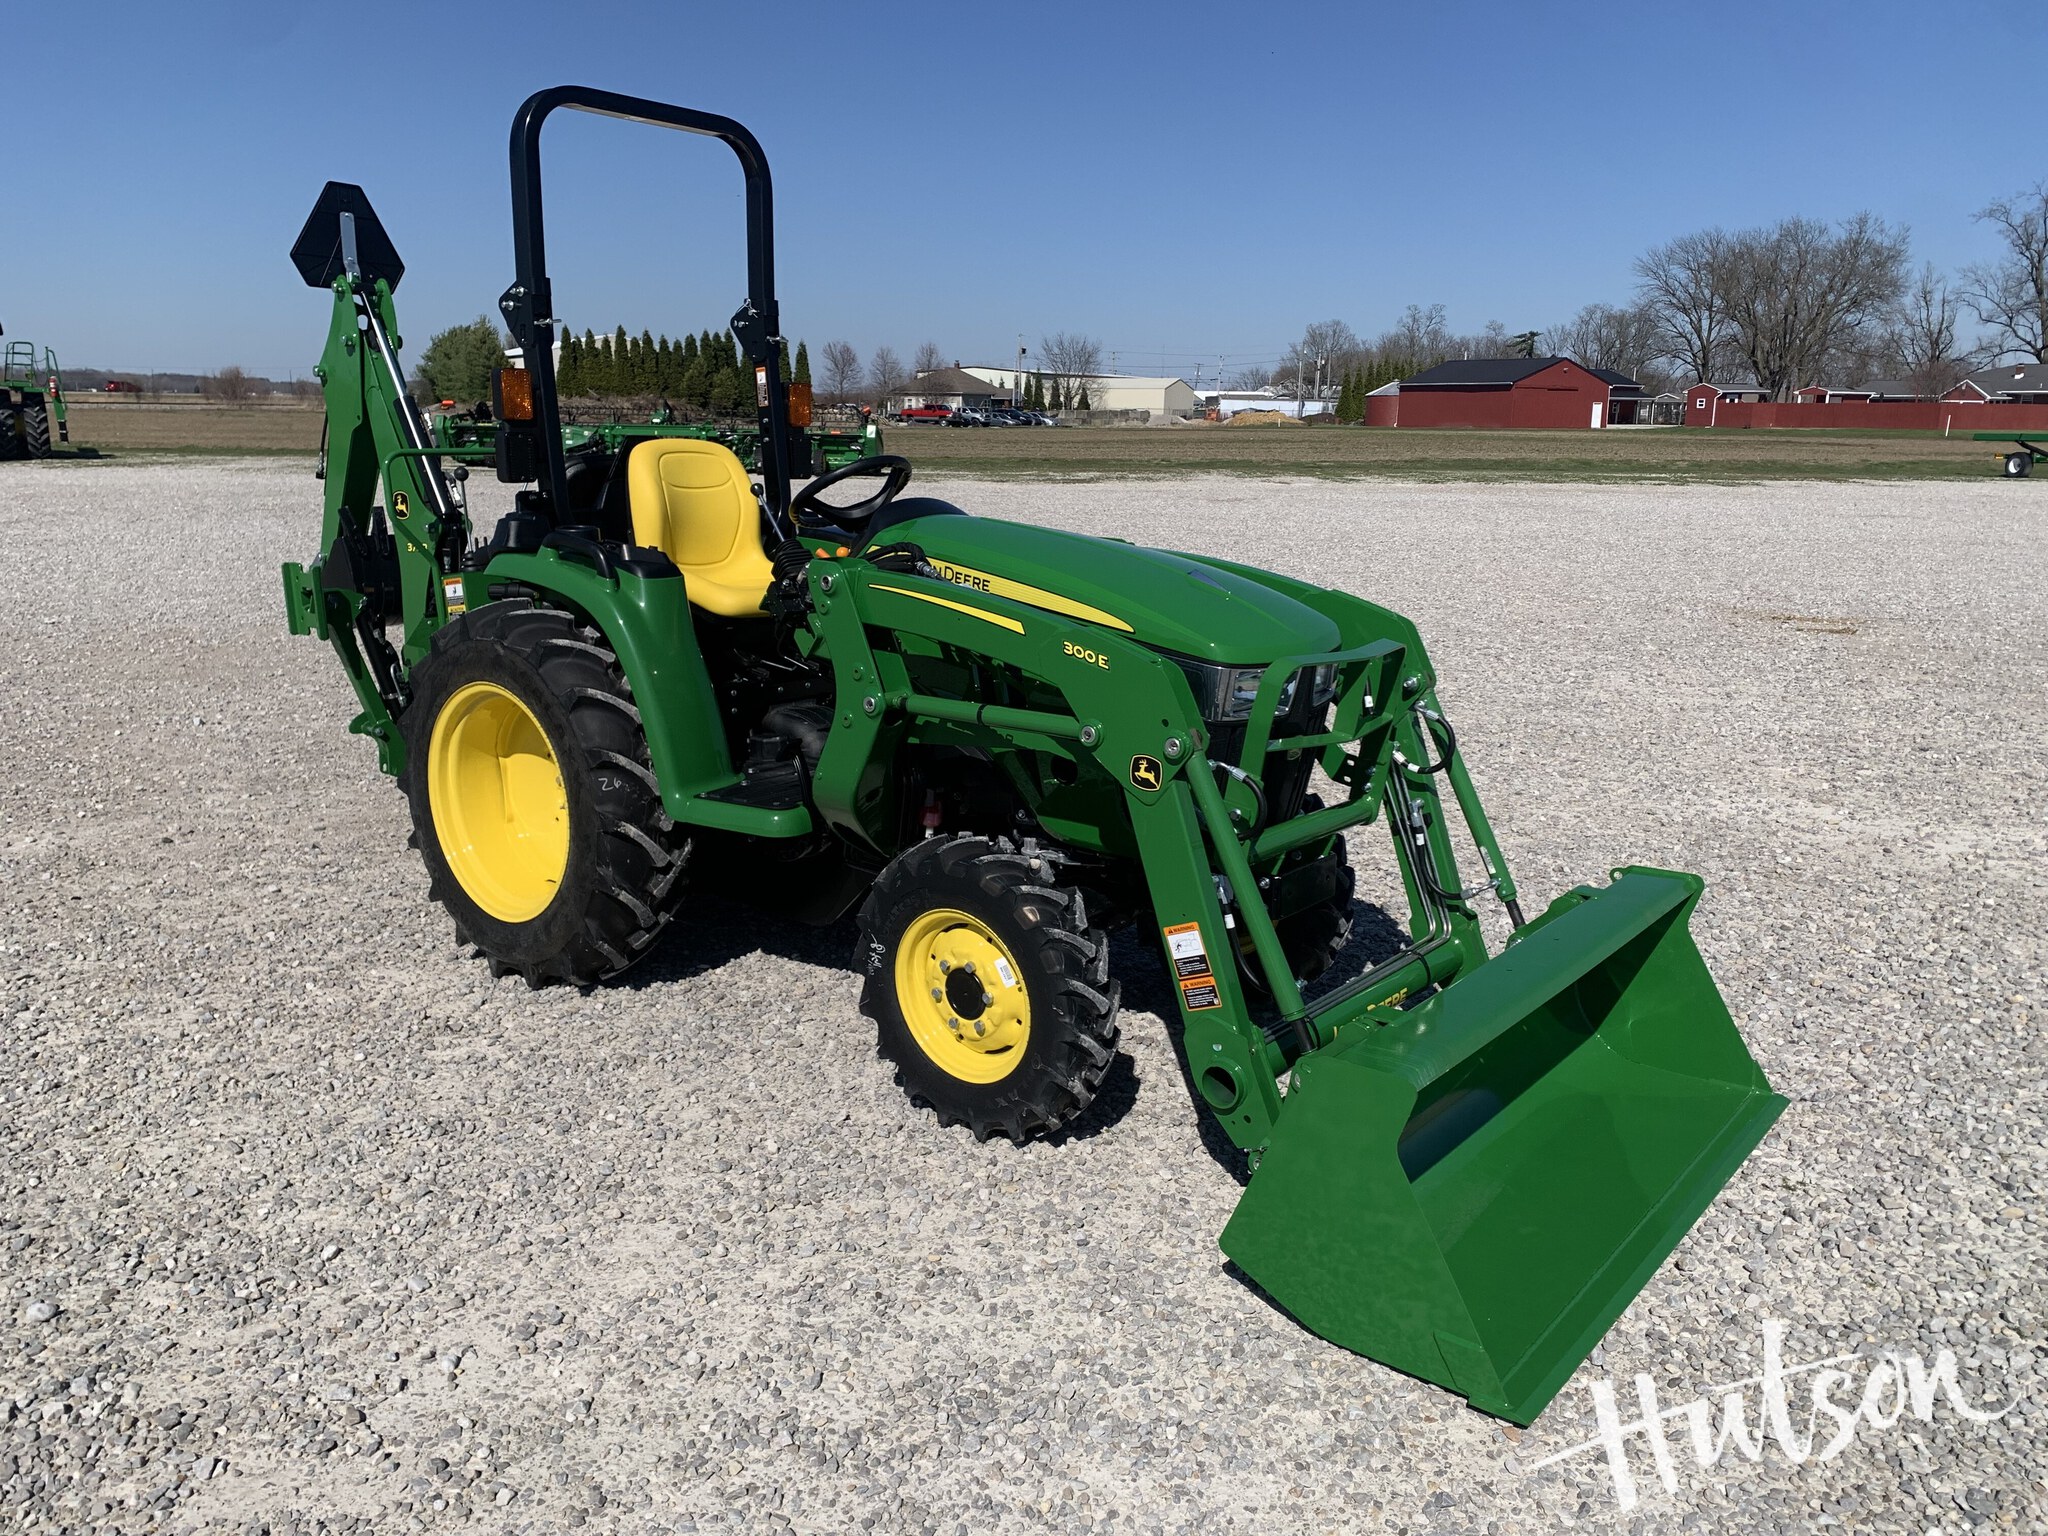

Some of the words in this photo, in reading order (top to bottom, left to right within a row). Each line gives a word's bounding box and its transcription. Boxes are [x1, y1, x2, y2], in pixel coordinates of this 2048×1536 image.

[944, 566, 991, 592] DEERE
[1063, 640, 1109, 670] 300E
[1173, 925, 1195, 933] WARNING
[1189, 979, 1212, 987] WARNING
[1366, 987, 1408, 1012] ERE
